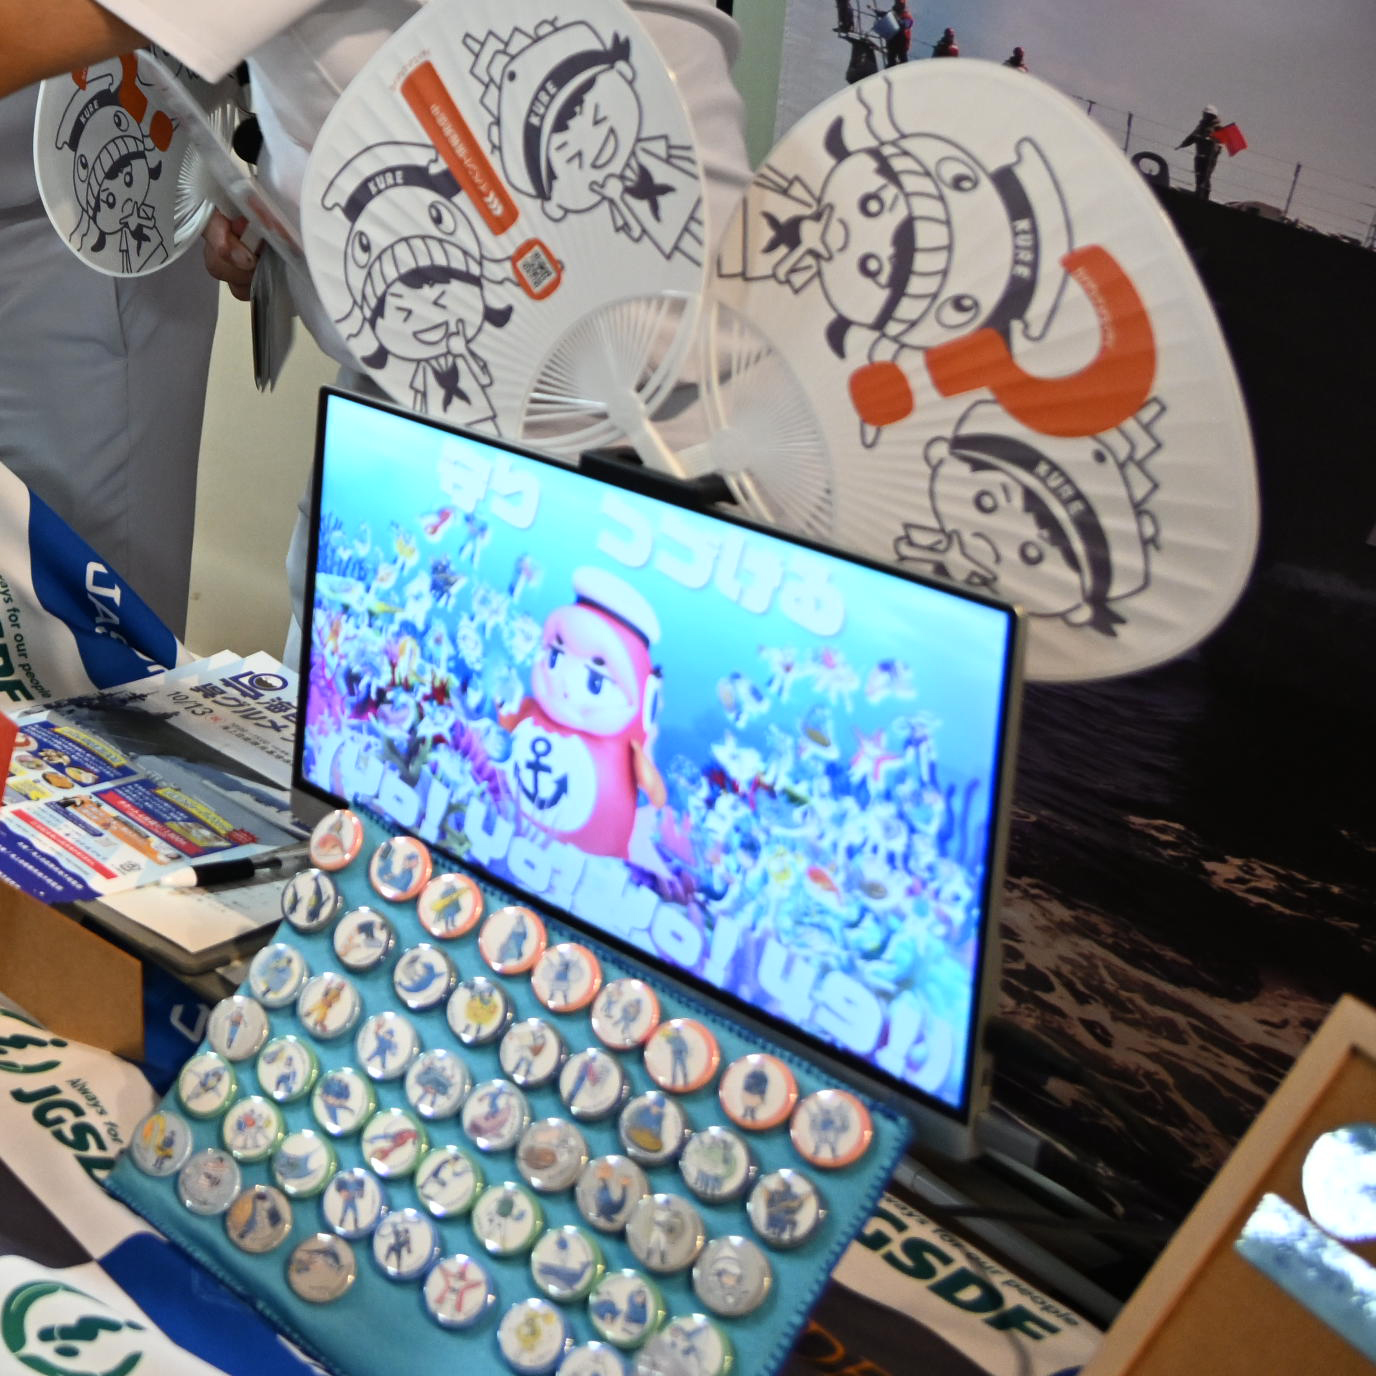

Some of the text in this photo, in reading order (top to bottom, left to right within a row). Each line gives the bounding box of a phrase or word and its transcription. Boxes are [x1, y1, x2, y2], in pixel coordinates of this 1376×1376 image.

[79, 99, 99, 125] KURE
[528, 79, 559, 129] KURE
[367, 170, 405, 196] KURE
[1012, 217, 1035, 280] KURE
[1033, 460, 1087, 519] KURE
[6, 607, 22, 630] for
[14, 633, 28, 662] our
[20, 661, 52, 699] people
[167, 691, 214, 716] 10/13
[9, 1084, 118, 1188] JGS
[65, 1077, 127, 1146] Always for
[852, 1205, 1062, 1341] GSDF
[932, 1225, 966, 1251] for
[966, 1249, 1005, 1276] our
[1002, 1277, 1080, 1327] people
